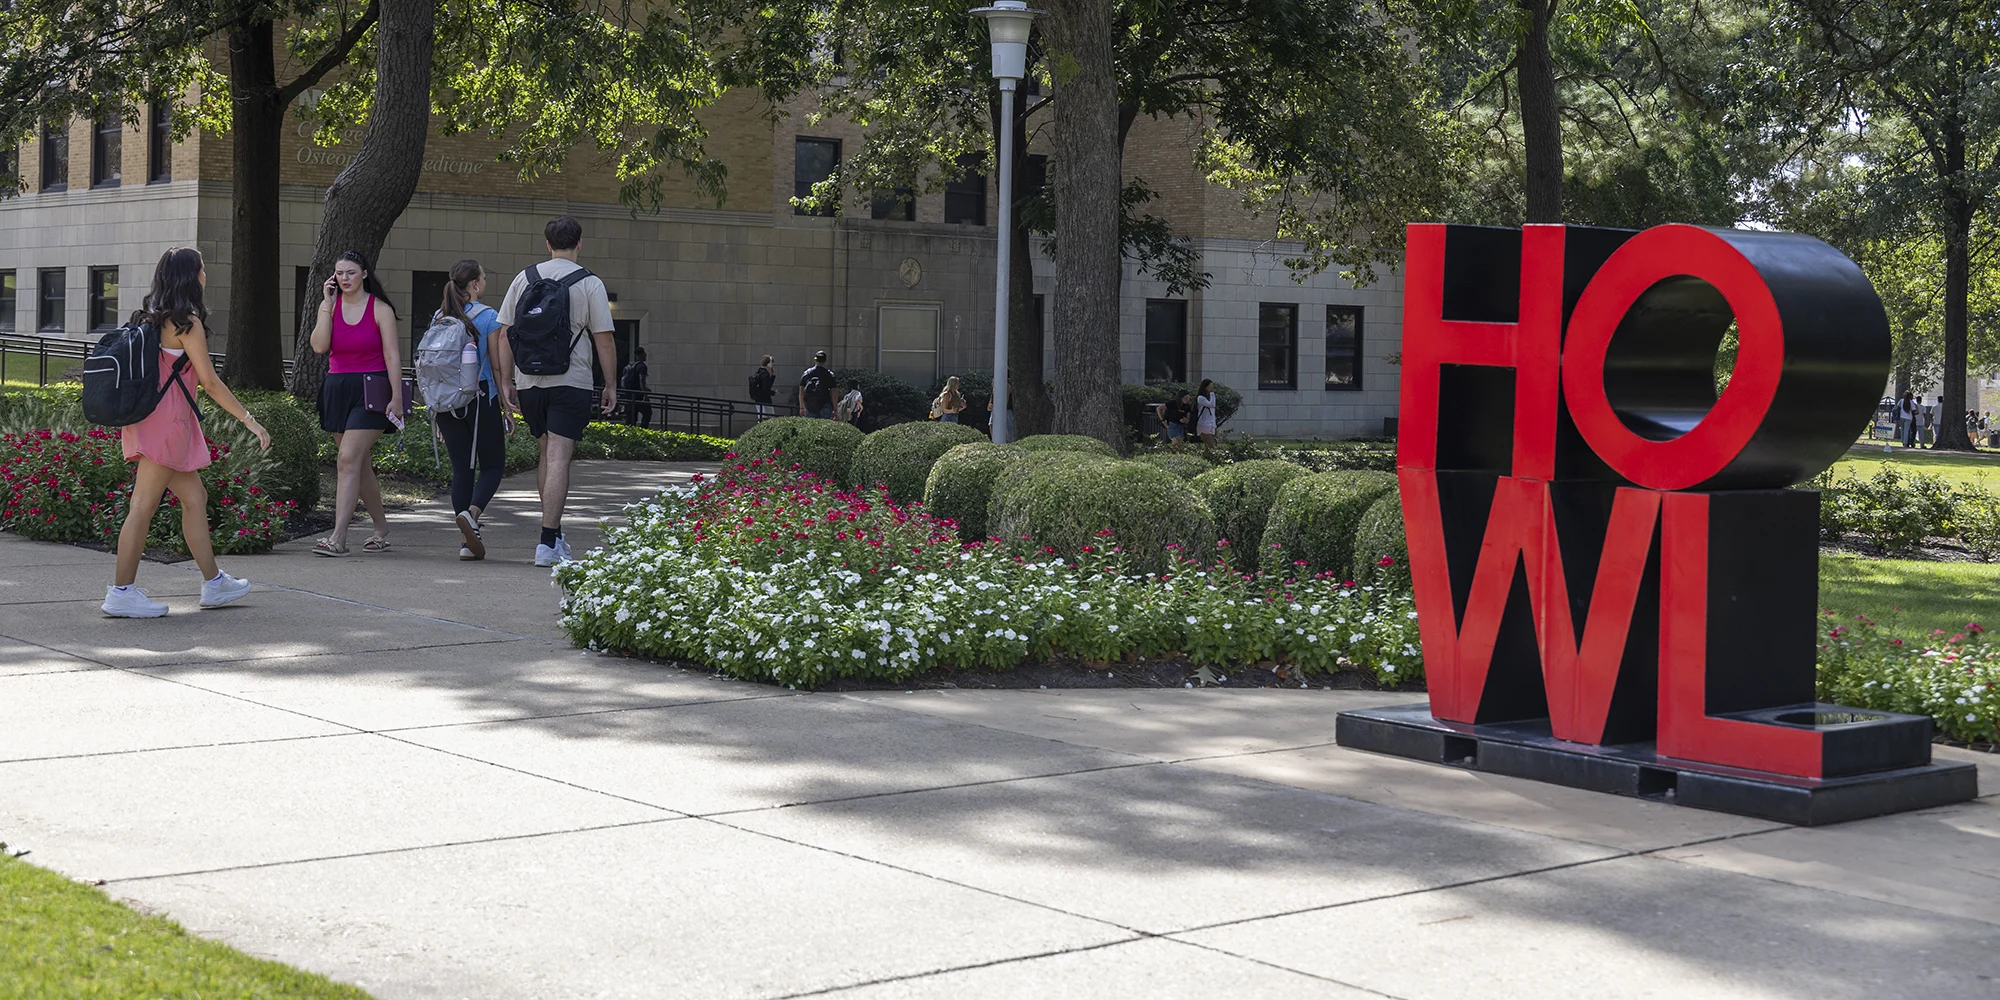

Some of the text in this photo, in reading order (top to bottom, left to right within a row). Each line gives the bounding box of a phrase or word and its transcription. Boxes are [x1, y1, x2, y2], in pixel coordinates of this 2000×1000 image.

[424, 155, 483, 174] edicine
[1398, 223, 1785, 491] HO
[1398, 467, 1823, 779] WL
